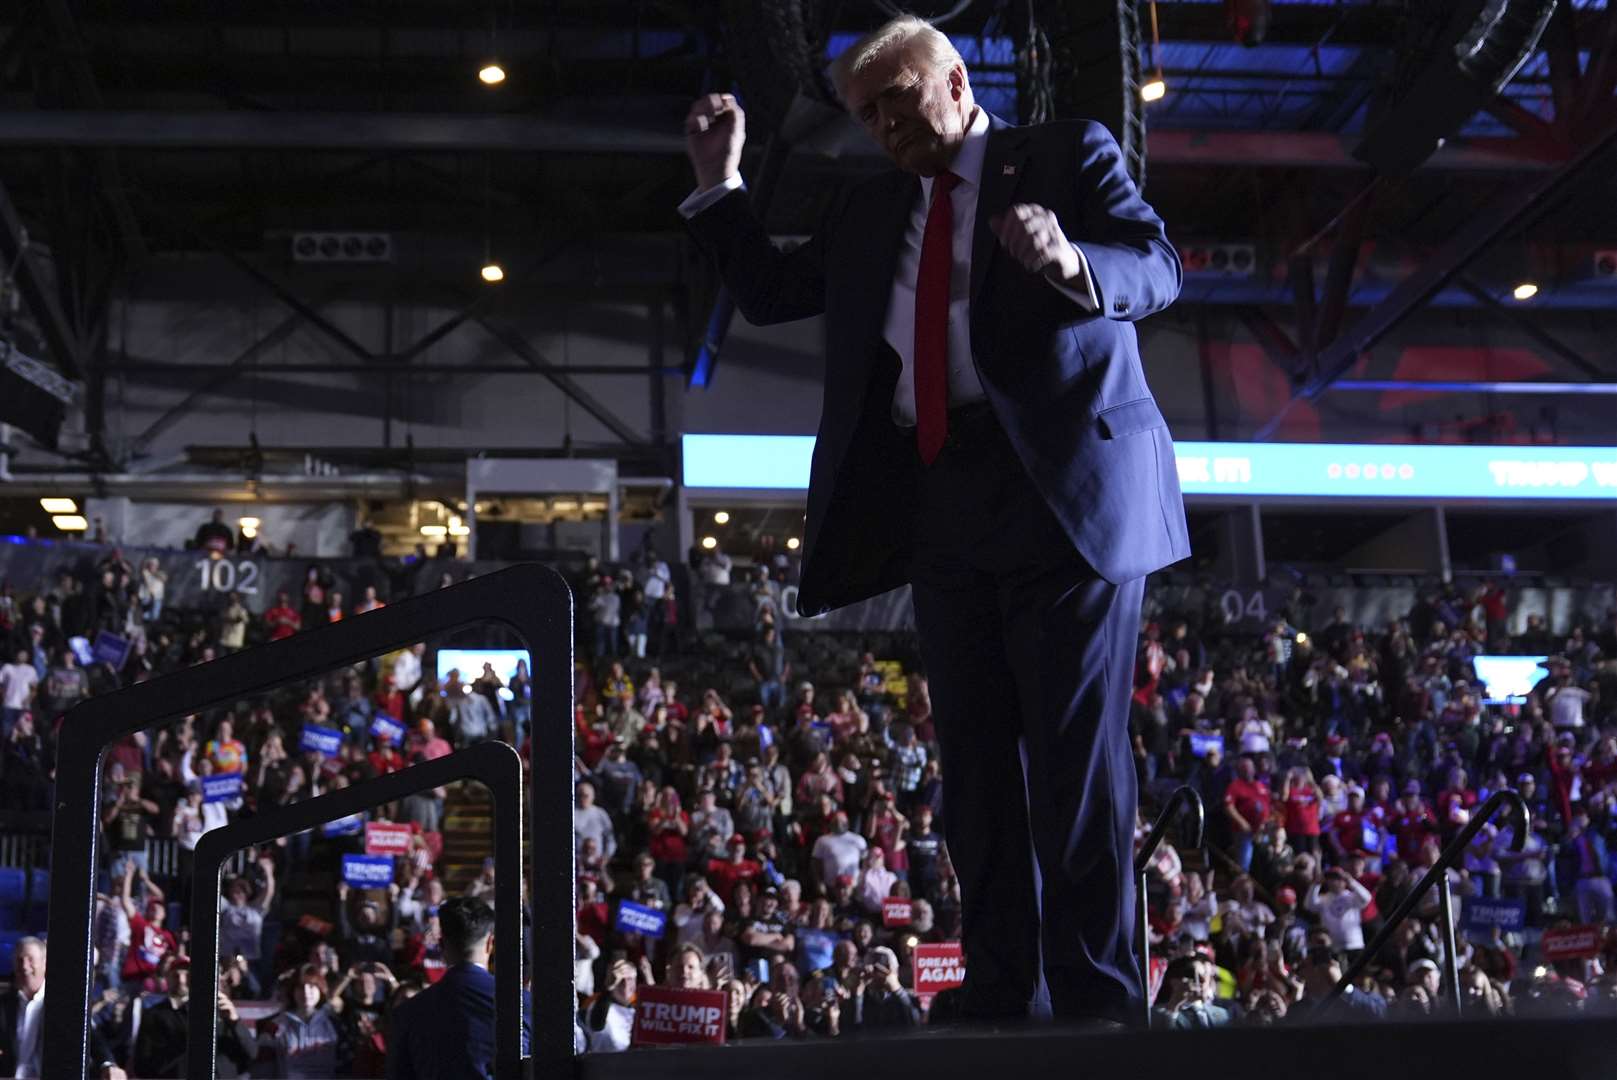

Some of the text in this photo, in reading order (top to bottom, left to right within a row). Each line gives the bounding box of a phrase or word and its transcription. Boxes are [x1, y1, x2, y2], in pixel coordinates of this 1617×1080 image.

[1487, 461, 1587, 486] TRUMP
[195, 558, 258, 594] 102
[918, 957, 959, 968] DREAM
[640, 1001, 720, 1025] TRUMP
[640, 1018, 719, 1037] WILL FIX IT
